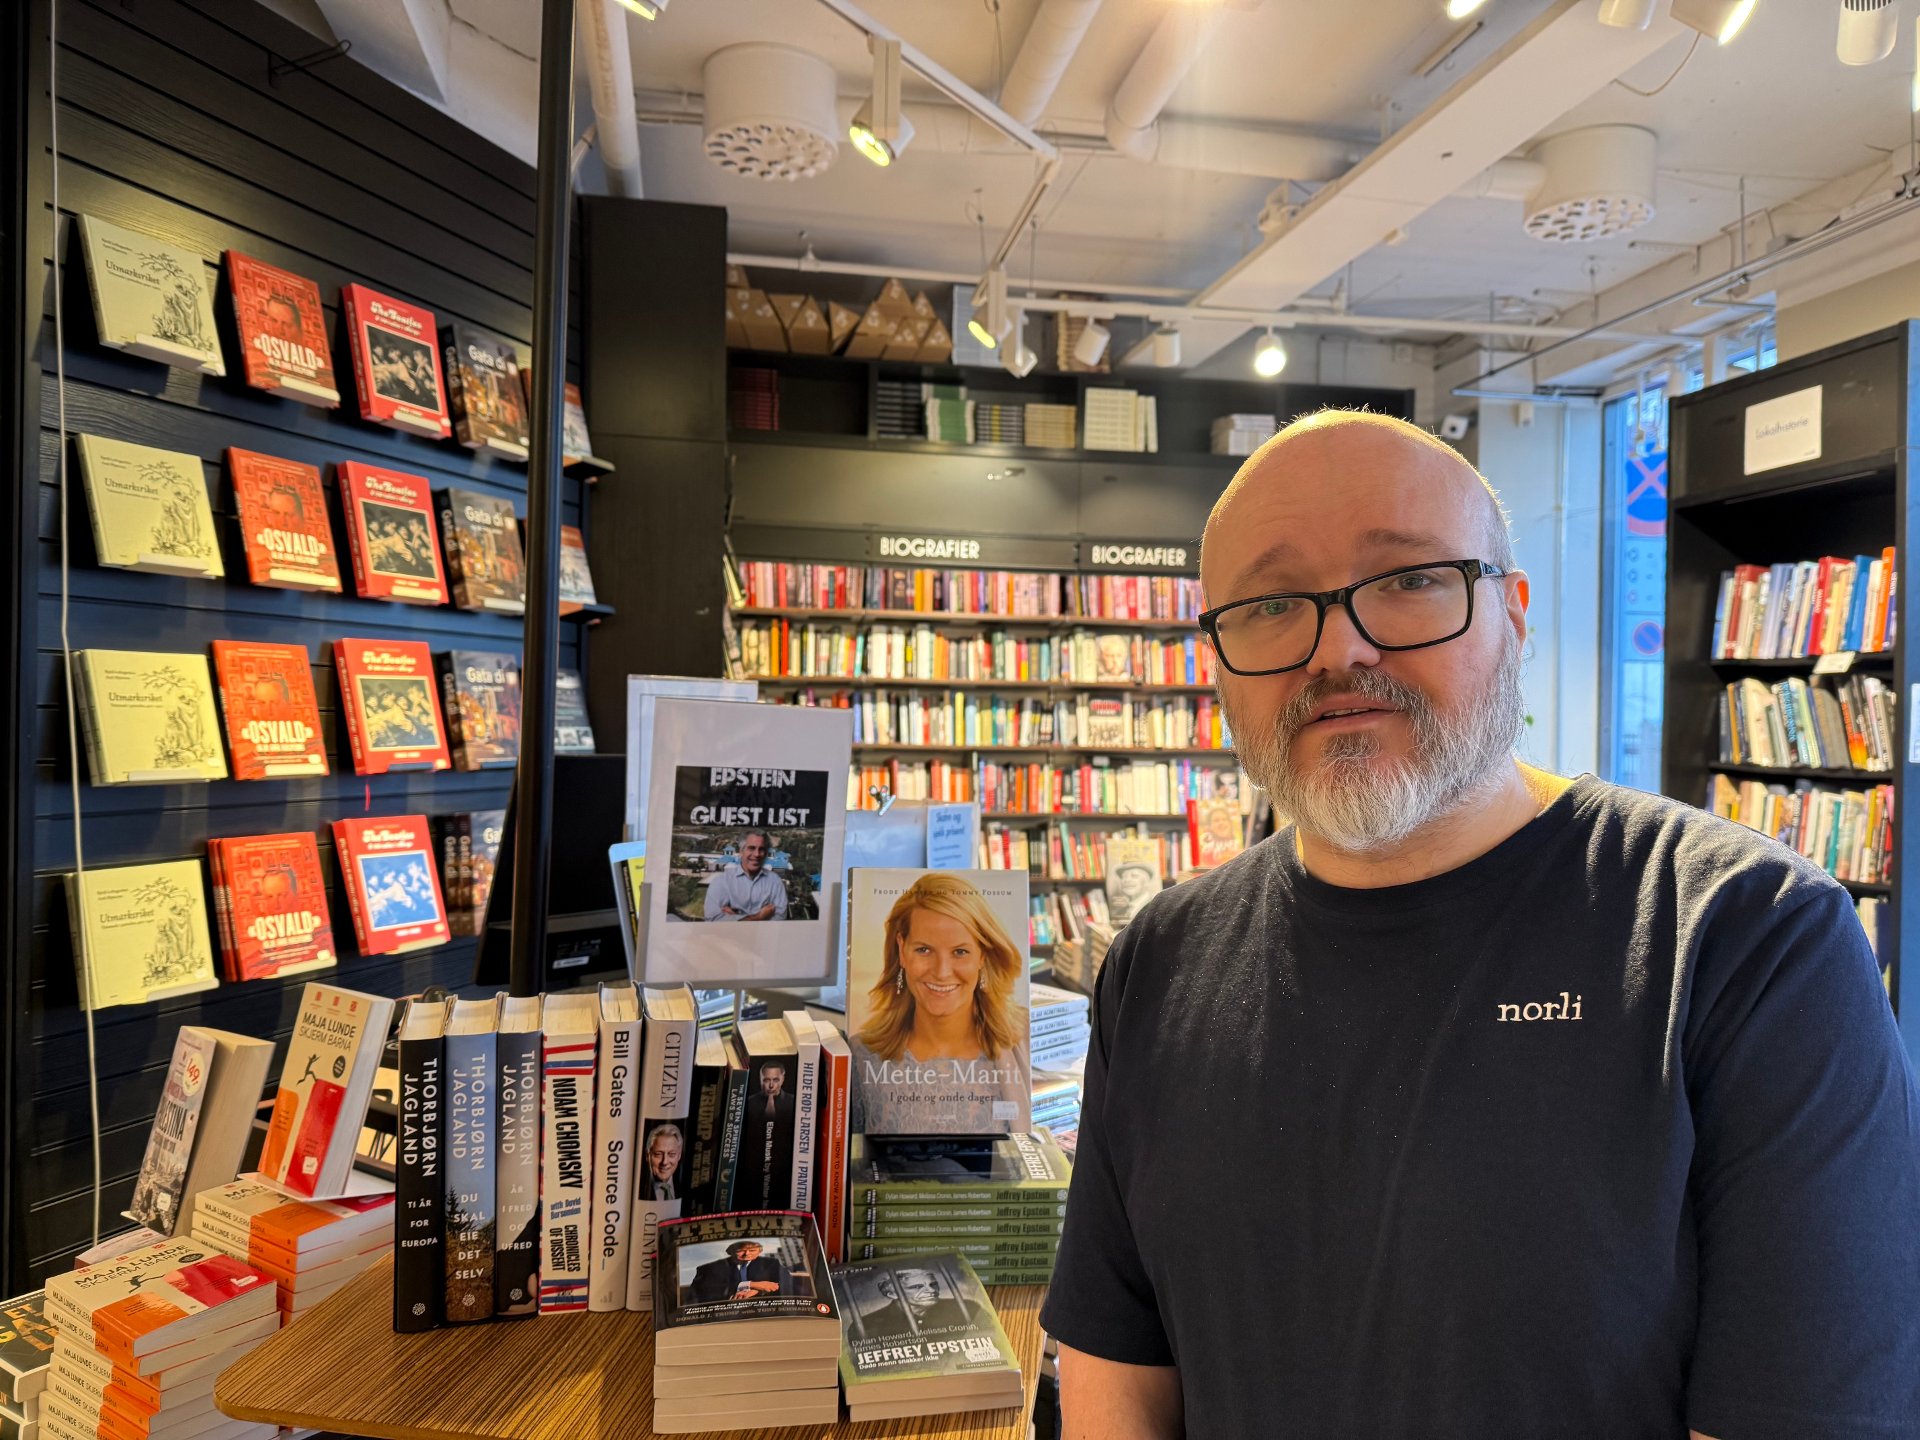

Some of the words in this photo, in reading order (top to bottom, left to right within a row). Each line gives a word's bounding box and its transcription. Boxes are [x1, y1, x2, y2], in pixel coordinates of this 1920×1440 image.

[105, 478, 158, 495] Utmarksriket
[464, 505, 491, 524] Gata
[880, 536, 980, 560] BIOGRAFIER
[1092, 545, 1186, 566] BIOGRAFIER
[466, 666, 494, 684] Gata
[710, 767, 796, 788] EPSTEIN
[690, 806, 763, 826] GUEST
[768, 808, 810, 827] LIST
[100, 909, 154, 924] Utmarksriket
[1497, 992, 1583, 1021] norli
[302, 1012, 326, 1029] MAJA
[328, 1019, 356, 1038] LUNDE
[299, 1026, 327, 1042] SKJERM
[328, 1034, 351, 1052] BARNA
[613, 1030, 630, 1059] Bill
[661, 1031, 682, 1109] CITIZEN
[802, 1062, 814, 1090] HILDE
[863, 1060, 1022, 1086] Mette-Marit
[552, 1078, 577, 1118] NOAM
[610, 1065, 628, 1118] Gates
[729, 1088, 737, 1110] LAWS
[890, 1092, 894, 1101] I
[896, 1092, 921, 1104] gode
[924, 1095, 936, 1104] og
[940, 1092, 965, 1101] onde
[967, 1092, 996, 1104] dager
[403, 1074, 418, 1165] JAGLAND
[422, 1058, 438, 1177] THORBJØRN
[452, 1069, 467, 1159] JAGLAND
[471, 1054, 486, 1170] THORBJØRN
[502, 1065, 517, 1154] JAGLAND
[521, 1050, 535, 1166] THORBJØRN
[697, 1084, 716, 1140] TRUMP
[735, 1096, 743, 1122] SEVEN
[766, 1121, 774, 1139] Elon
[799, 1093, 812, 1154] RØD-LARSEN
[723, 1123, 733, 1158] SUCCESS
[729, 1125, 739, 1163] SPIRITUAL
[764, 1141, 772, 1162] Musk
[556, 1121, 583, 1189] CHOMSKY
[606, 1140, 624, 1204] Source
[461, 1193, 478, 1203] DU
[510, 1184, 523, 1194] ÅR
[996, 1191, 1020, 1201] Jeffrey
[1023, 1191, 1050, 1201] Epstein
[205, 1202, 216, 1212] MAJA
[217, 1209, 231, 1220] LUNDE
[407, 1200, 416, 1209] TI
[418, 1198, 432, 1208] ÅR
[508, 1204, 532, 1213] FRED
[996, 1207, 1020, 1217] Jeffrey
[1023, 1207, 1050, 1217] Epstein
[410, 1218, 429, 1228] FOR
[454, 1211, 485, 1223] SKAL
[509, 1223, 525, 1232] OG
[678, 1215, 802, 1238] TRUMP
[402, 1237, 438, 1248] EUROPA
[460, 1231, 478, 1242] EIE
[550, 1227, 563, 1237] OF
[674, 1238, 698, 1246] THE
[458, 1250, 480, 1260] DET
[502, 1241, 532, 1251] UFRED
[551, 1239, 565, 1271] DISSENT
[565, 1225, 580, 1272] CHRONICLES
[640, 1212, 656, 1280] CLINTON
[995, 1242, 1018, 1252] Jeffrey
[1021, 1241, 1048, 1251] Epstein
[74, 1265, 128, 1285] MAJA
[130, 1244, 188, 1266] LUNDE
[80, 1265, 143, 1290] SKJERM
[143, 1248, 195, 1268] BARNA
[456, 1268, 484, 1280] SELV
[53, 1290, 63, 1302] MAJA
[63, 1298, 76, 1312] LUNDE
[77, 1307, 92, 1322] SKJERM
[852, 1338, 877, 1347] Dylan
[878, 1331, 914, 1342] Howard,
[916, 1327, 948, 1336] Melissa
[949, 1323, 979, 1332] Cronin,
[854, 1344, 882, 1352] James
[883, 1337, 928, 1348] Robertson
[858, 1344, 922, 1365] JEFFREY
[927, 1336, 994, 1355] EPSTEIN
[64, 1348, 76, 1361] MAJA
[77, 1355, 92, 1368] LUNDE
[93, 1363, 111, 1378] SKJERM
[859, 1362, 877, 1370] Døde
